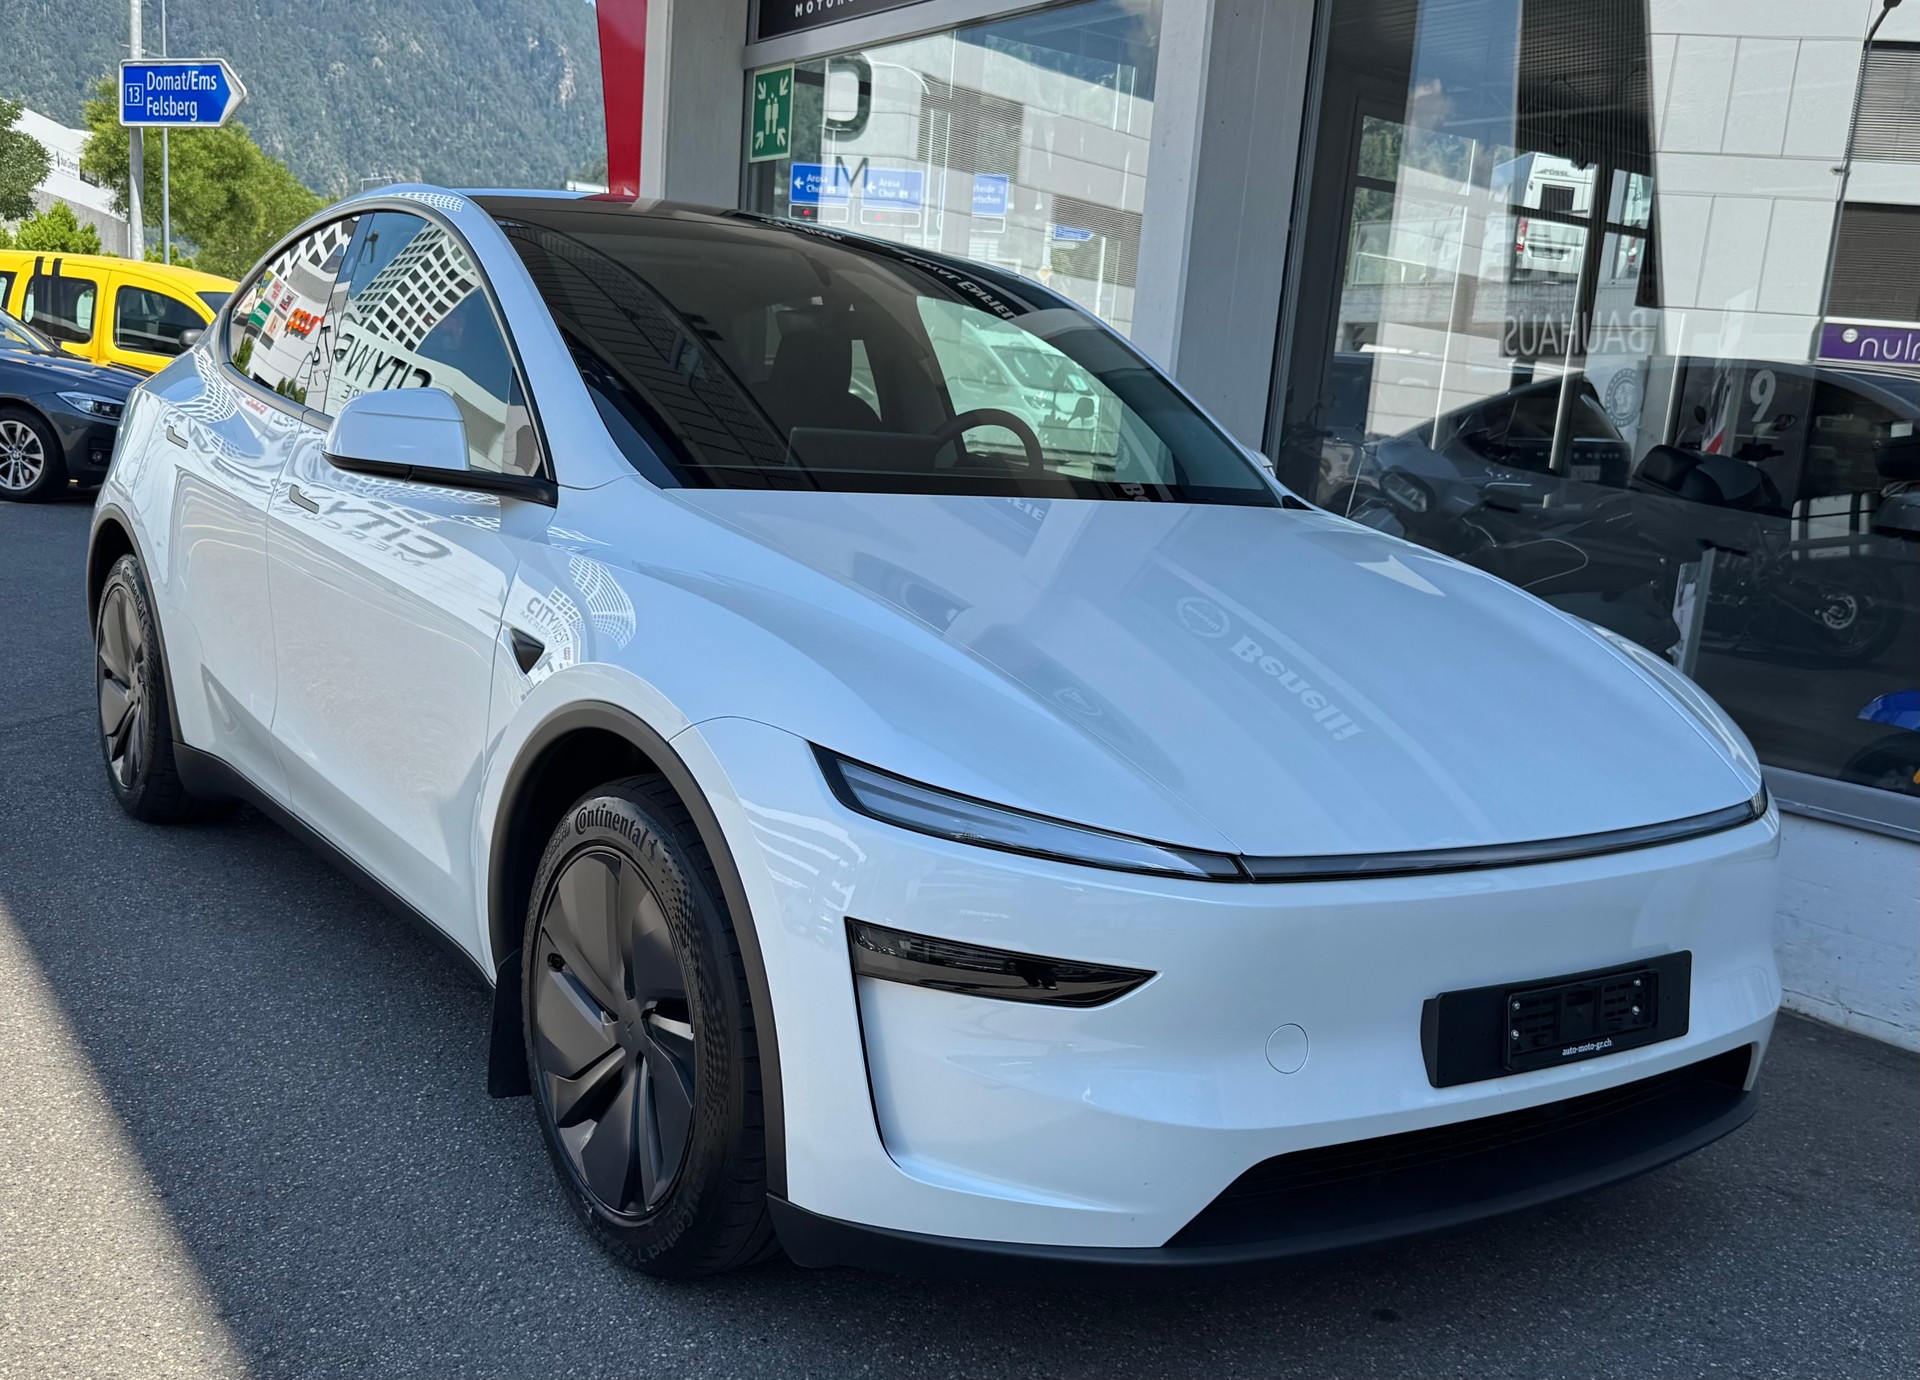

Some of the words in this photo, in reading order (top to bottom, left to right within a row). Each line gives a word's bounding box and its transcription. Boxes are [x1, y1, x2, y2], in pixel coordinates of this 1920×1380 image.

[795, 0, 854, 17] MOTO
[147, 71, 217, 91] Domat/Ems
[128, 87, 140, 103] 13
[147, 95, 198, 122] Felsberg
[575, 803, 650, 853] Continental
[1562, 1038, 1612, 1056] auto-moto-gr.ch
